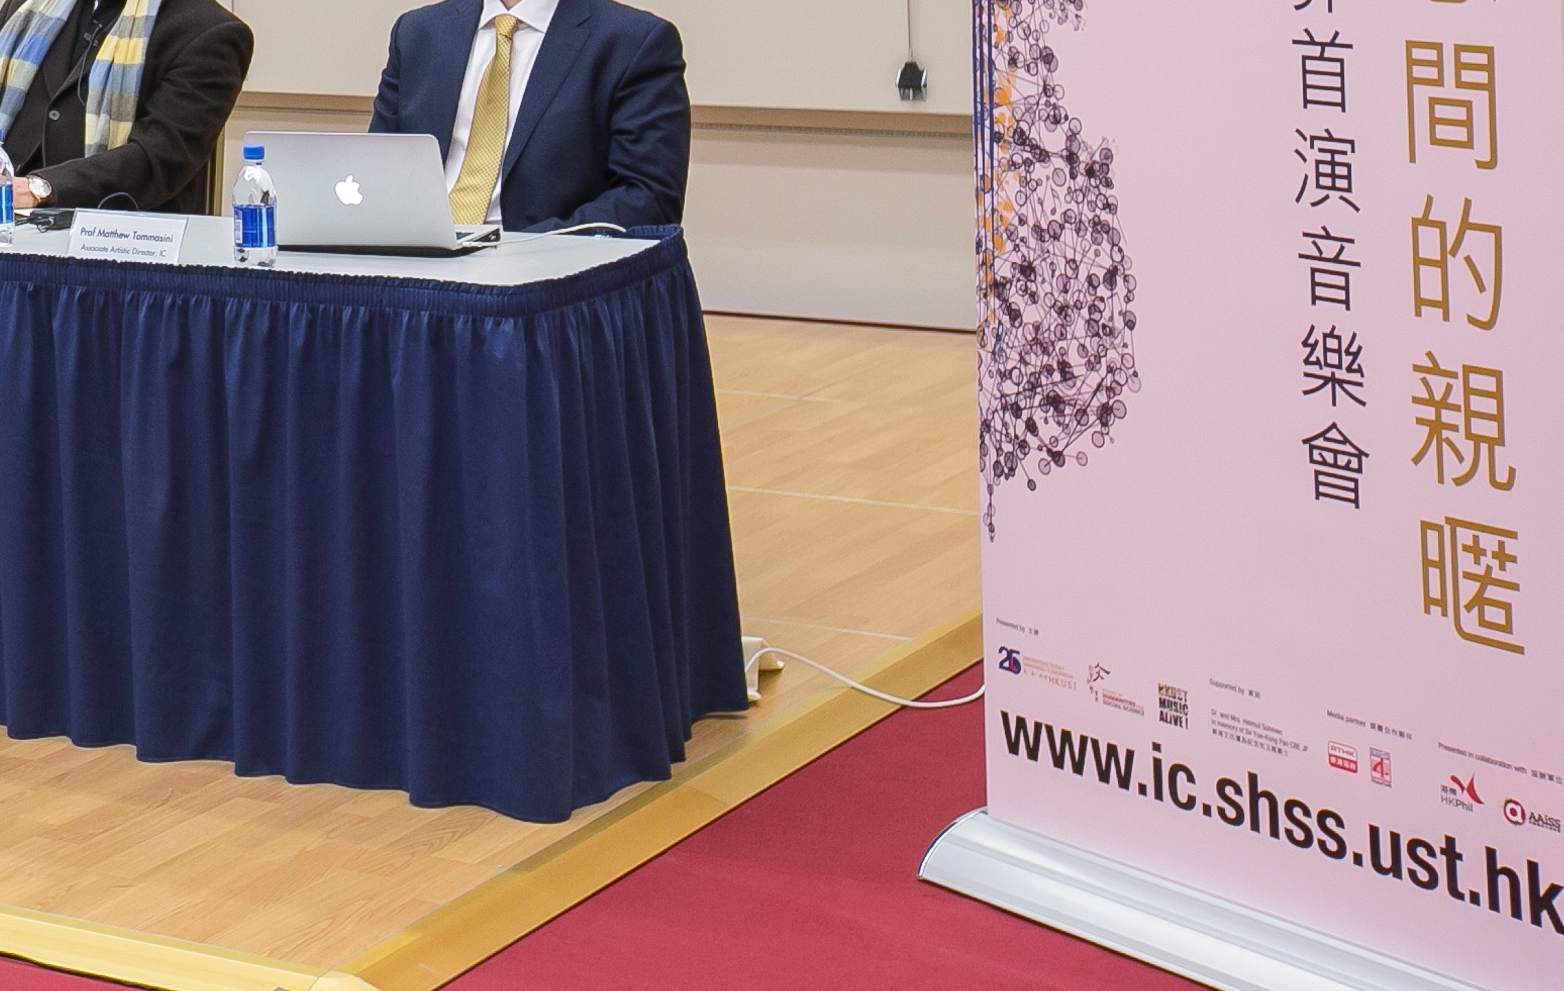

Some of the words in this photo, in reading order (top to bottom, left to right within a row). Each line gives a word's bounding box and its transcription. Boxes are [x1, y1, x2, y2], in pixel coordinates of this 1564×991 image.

[80, 227, 96, 238] Prof
[96, 228, 130, 240] Matthew
[132, 231, 174, 243] Tommasini
[80, 244, 108, 253] Associate
[110, 246, 130, 255] Artistic
[132, 248, 157, 258] Director,
[160, 250, 167, 258] IC
[1158, 697, 1189, 716] MUSIC
[1327, 709, 1344, 721] Media
[1345, 715, 1366, 728] partner
[1440, 795, 1474, 812] HKPhil
[1000, 710, 1564, 936] www.ic.shss.ust.hk
